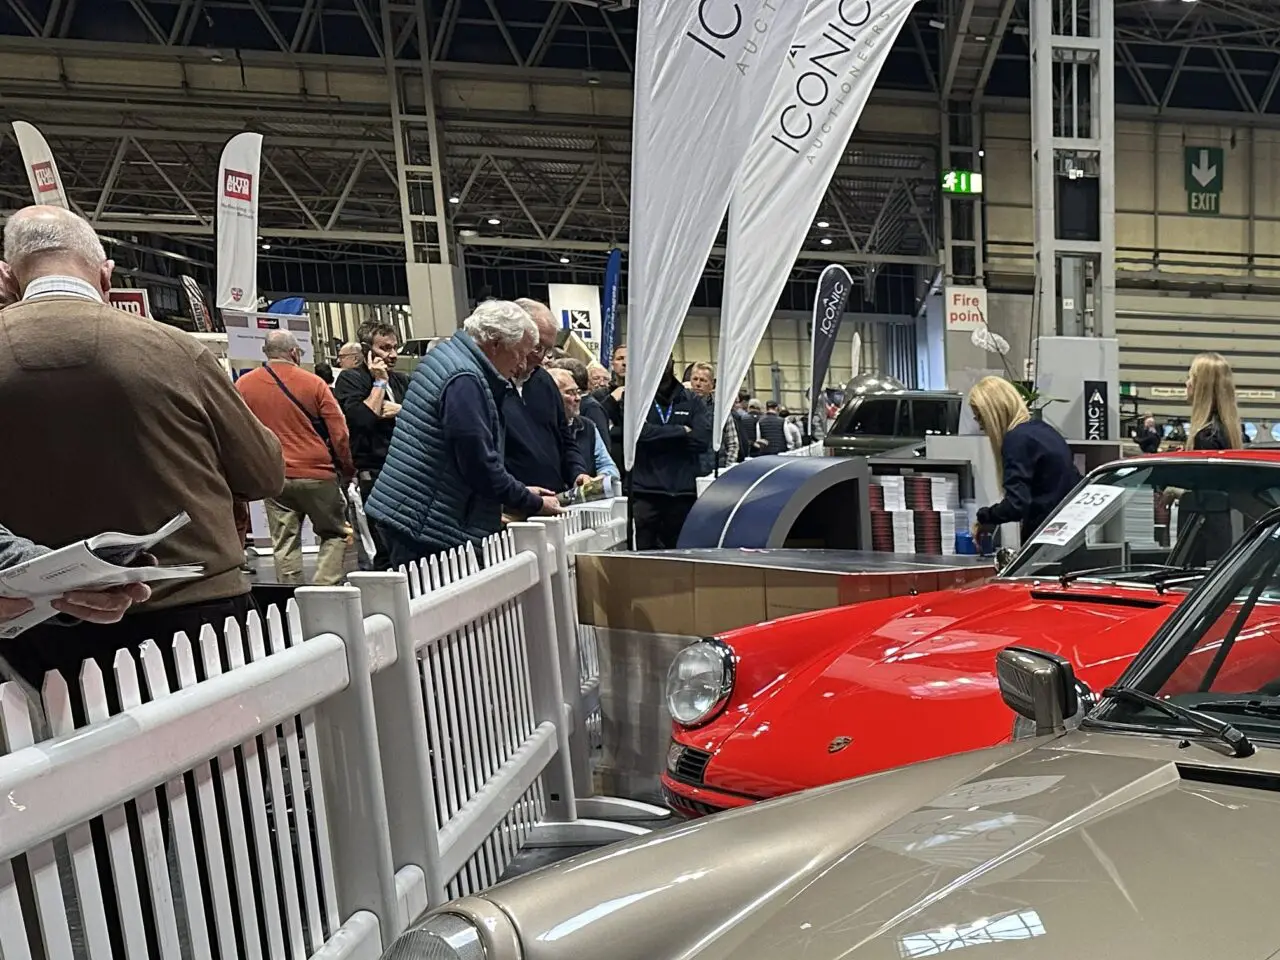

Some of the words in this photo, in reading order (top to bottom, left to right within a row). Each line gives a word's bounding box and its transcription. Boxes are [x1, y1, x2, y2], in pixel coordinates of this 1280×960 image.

[806, 11, 891, 164] AUCTIONEERS
[1191, 193, 1217, 210] EXIT
[820, 281, 844, 335] ICONIC
[953, 293, 979, 307] Fire
[1075, 492, 1109, 507] 255
